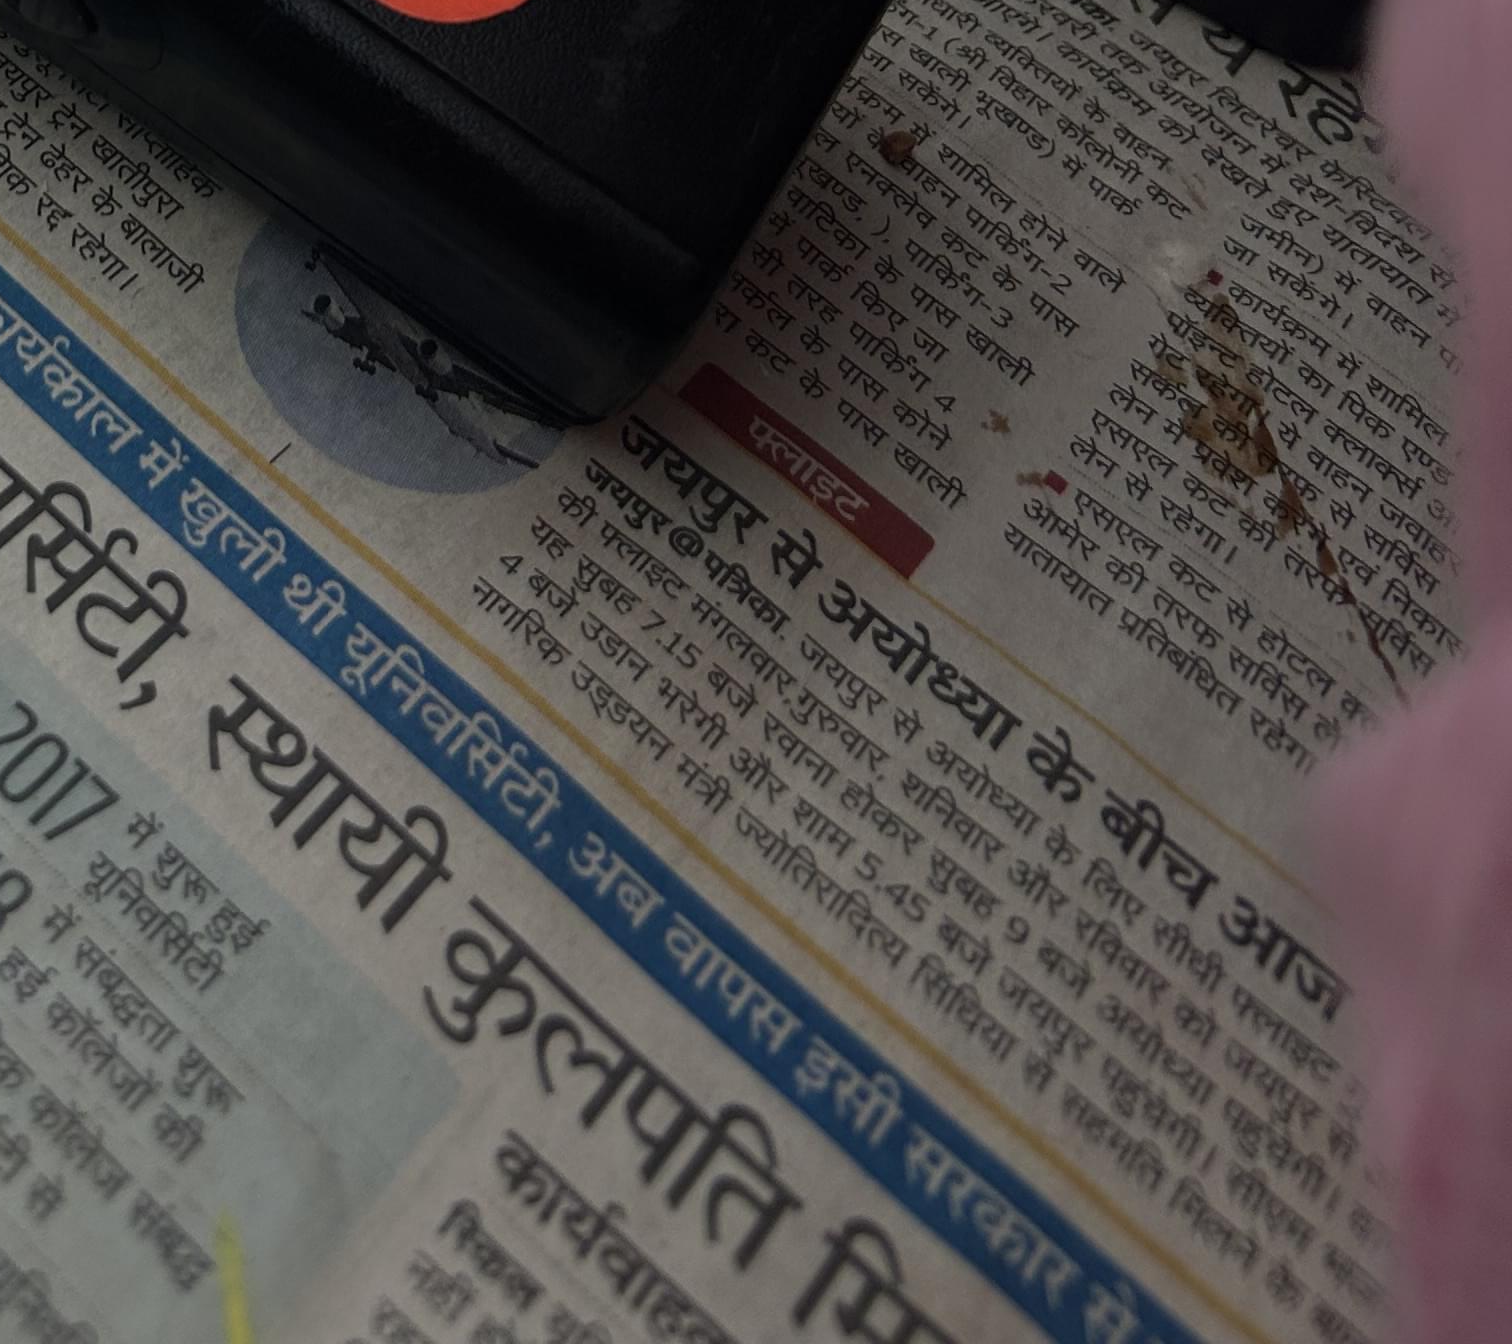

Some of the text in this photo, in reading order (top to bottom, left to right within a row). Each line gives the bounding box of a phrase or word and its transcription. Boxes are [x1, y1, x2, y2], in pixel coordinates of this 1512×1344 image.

[36, 192, 74, 232] रद्द
[71, 222, 139, 291] रहेगा।
[786, 184, 1035, 387] वाटिका के पास खाली
[937, 143, 1127, 294] शामिल होने वाले
[1228, 280, 1333, 359] कार्यक्रम
[1337, 351, 1363, 380] में
[748, 413, 871, 523] फ्लाइट
[1069, 434, 1238, 565] लेन से रहेगा।
[584, 456, 924, 744] जयपुर@पत्रिका. जयपुर से
[1023, 498, 1101, 562] आमेर
[1105, 554, 1149, 594] की
[1153, 586, 1224, 650] तरफ
[620, 413, 770, 546] जयपुर
[771, 528, 824, 590] से
[817, 578, 1023, 752] अयोध्या
[1026, 726, 1096, 804] के
[1100, 789, 1219, 911] बीच
[499, 555, 524, 575] 4
[528, 568, 580, 618] बजे
[658, 676, 729, 751] भरेगी
[729, 746, 789, 804] और
[792, 797, 856, 858] शाम
[855, 851, 930, 923] 5.45
[938, 915, 994, 977] बजे
[83, 851, 225, 992] यूनिवर्सिटी
[127, 812, 163, 850] में
[151, 842, 220, 905] शुरू
[204, 899, 270, 955] हुई
[139, 438, 189, 489] में
[180, 478, 287, 582] खुली
[283, 574, 346, 636] थी
[340, 622, 560, 847] यूनिवर्सिटी,
[569, 832, 665, 928] अब
[665, 913, 801, 1052] वापस
[794, 1037, 902, 1143] इसी
[906, 1128, 1078, 1294] सरकार
[43, 904, 82, 944] में
[75, 936, 181, 1053] संबद्धता
[208, 681, 453, 934] स्थायी
[425, 910, 803, 1272] कुलपति
